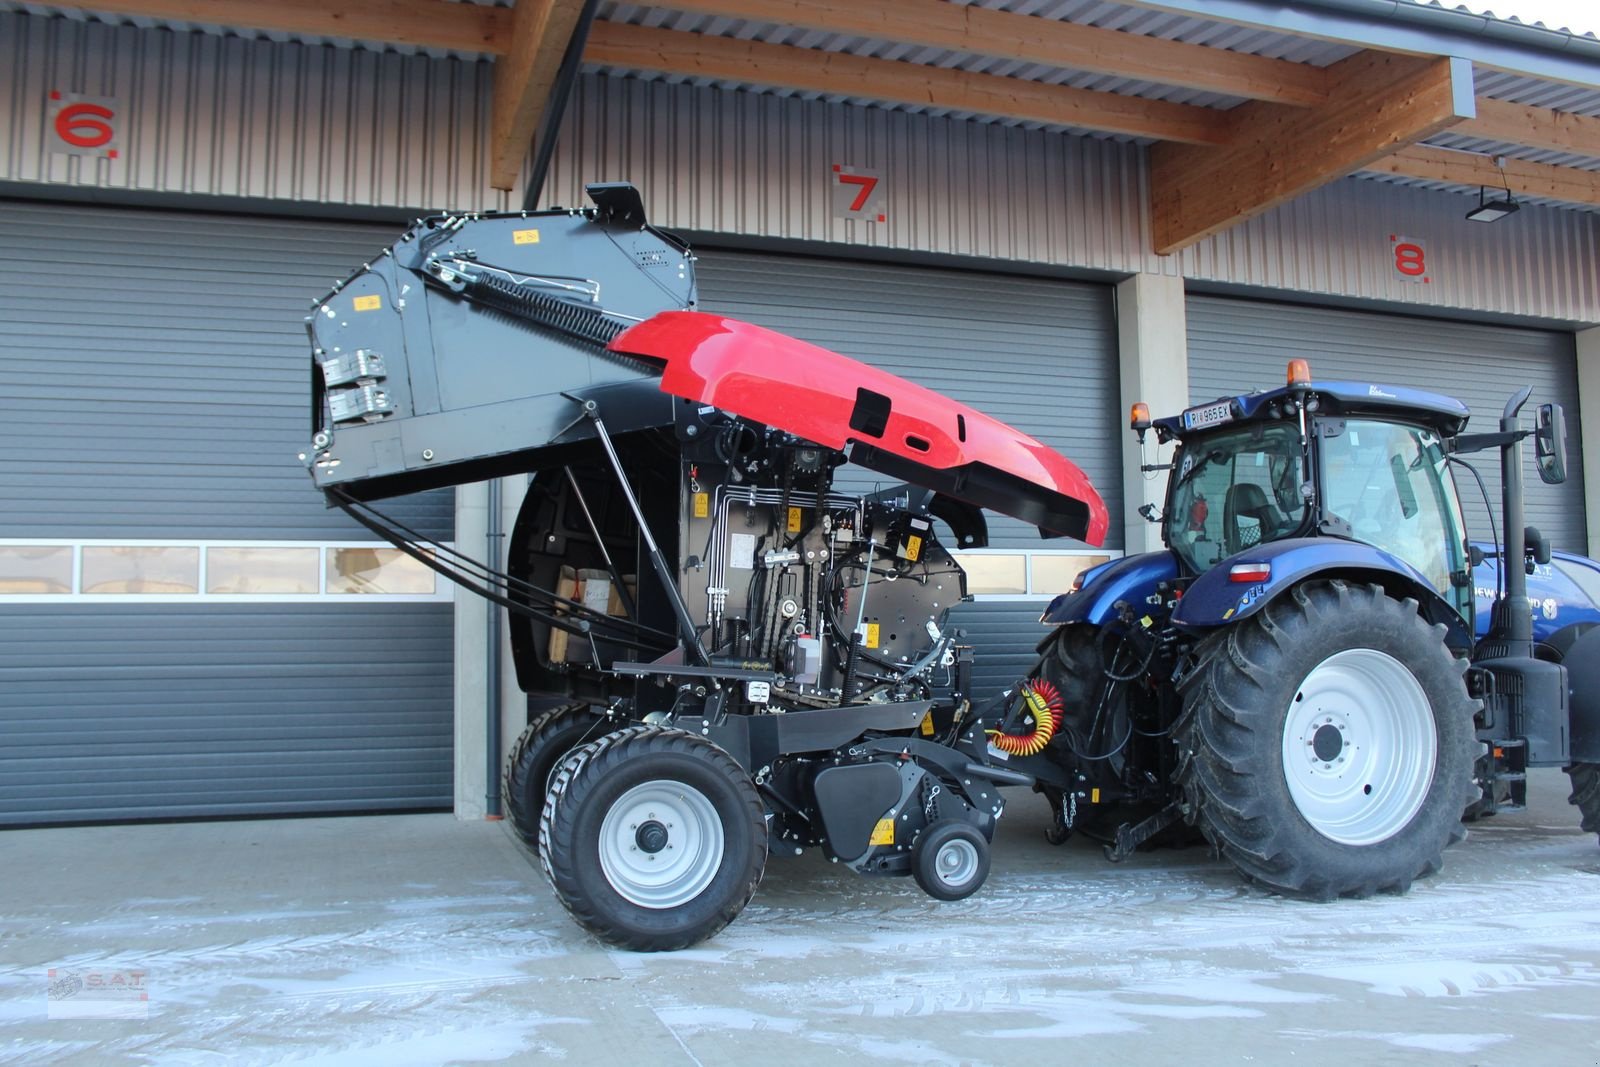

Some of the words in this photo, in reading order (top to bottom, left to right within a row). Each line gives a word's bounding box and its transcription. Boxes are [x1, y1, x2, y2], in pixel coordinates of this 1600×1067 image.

[55, 103, 114, 147] 6
[838, 174, 878, 211] 7
[1395, 243, 1425, 276] 8
